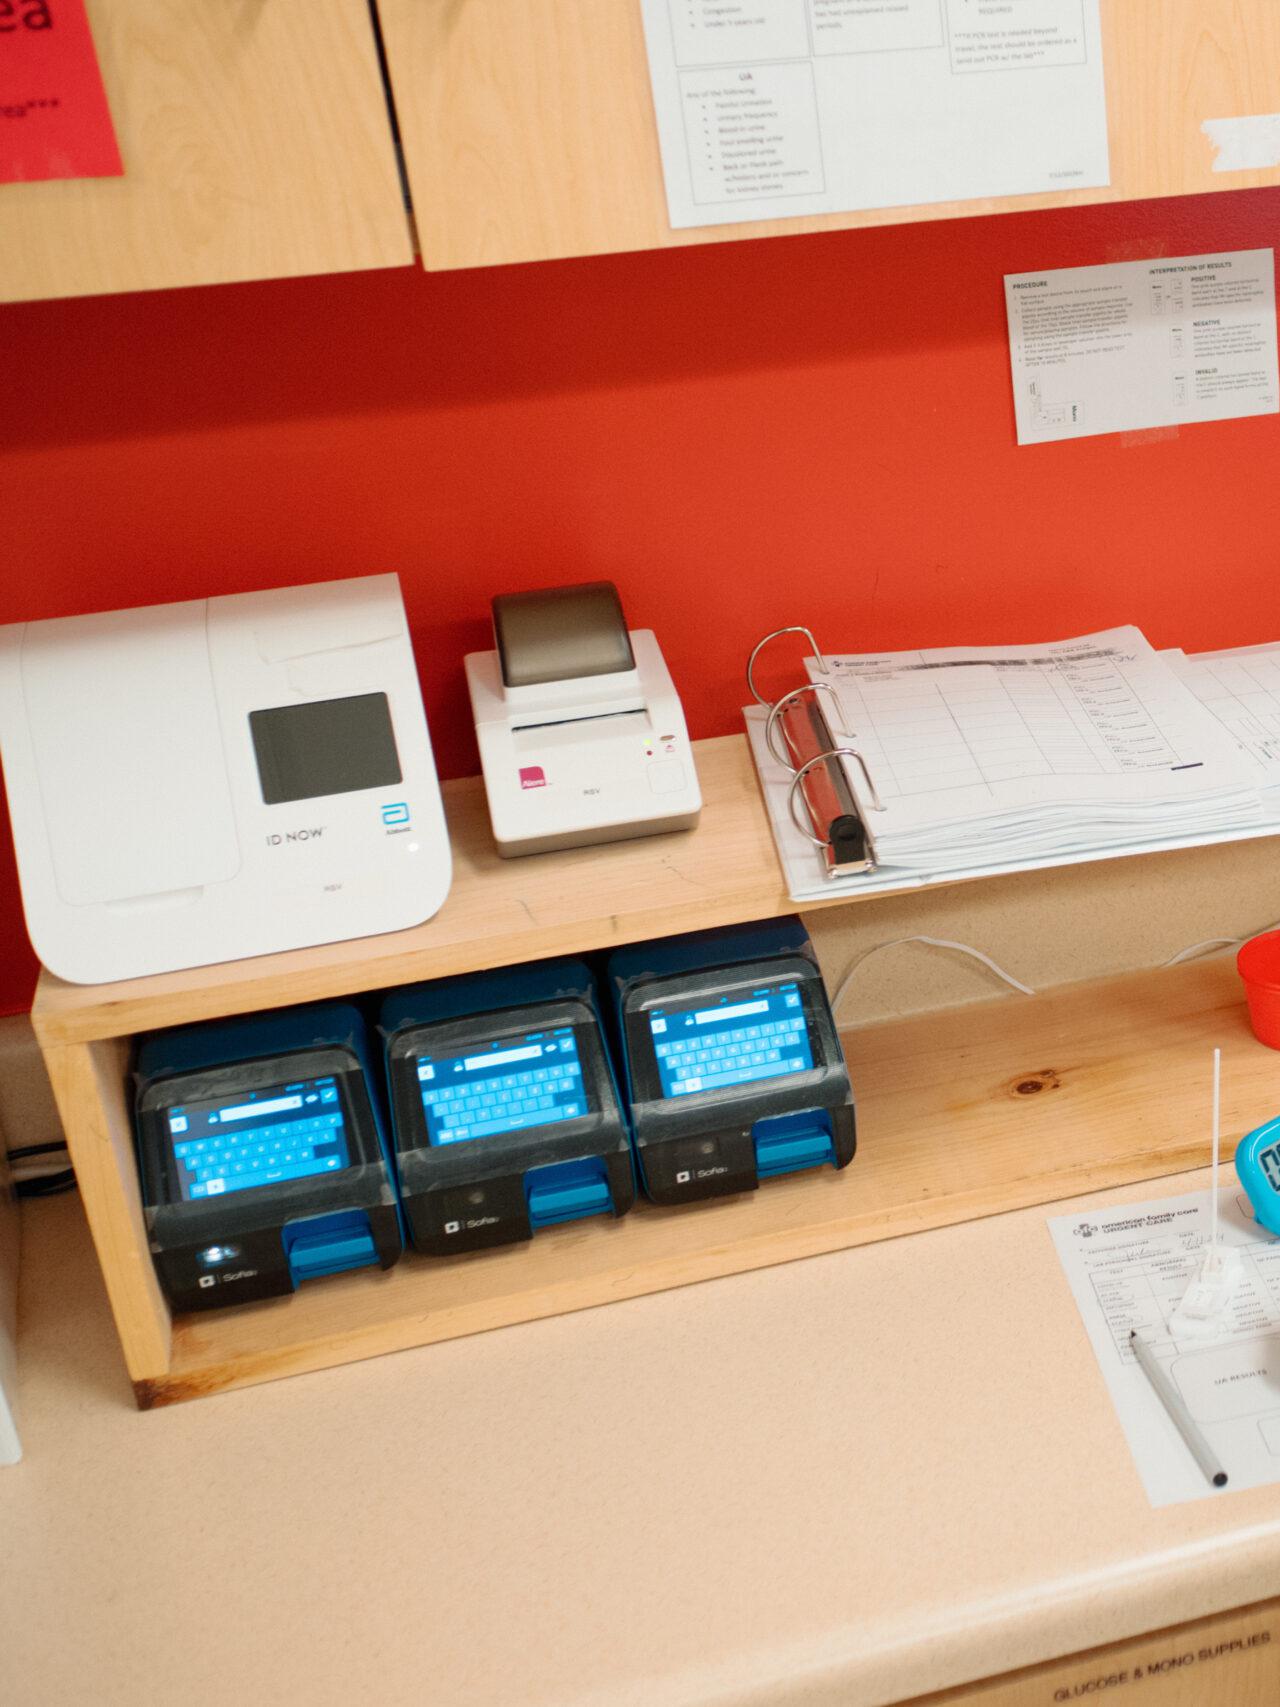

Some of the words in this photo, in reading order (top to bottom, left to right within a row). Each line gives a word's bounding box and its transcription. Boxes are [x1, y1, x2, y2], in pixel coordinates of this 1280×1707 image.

[739, 72, 753, 81] UA
[1149, 265, 1198, 275] INTERPRETATION
[1191, 274, 1216, 282] POSITIVE
[1012, 280, 1048, 290] PROCEDURE
[1193, 319, 1220, 327] NEGATIVE
[266, 834, 282, 846] ID
[286, 827, 323, 843] NOW
[1101, 1216, 1146, 1230] american
[1146, 1212, 1176, 1223] family
[1177, 1208, 1199, 1217] care
[1103, 1223, 1143, 1234] URGENT
[1146, 1217, 1174, 1227] CARE
[1214, 1378, 1228, 1386] UA
[1230, 1368, 1267, 1382] RESULTS
[1053, 1670, 1129, 1702] GLUCOSE
[1133, 1667, 1144, 1679] &
[1147, 1653, 1195, 1676] MONO
[1198, 1630, 1272, 1663] SUPPLIES
